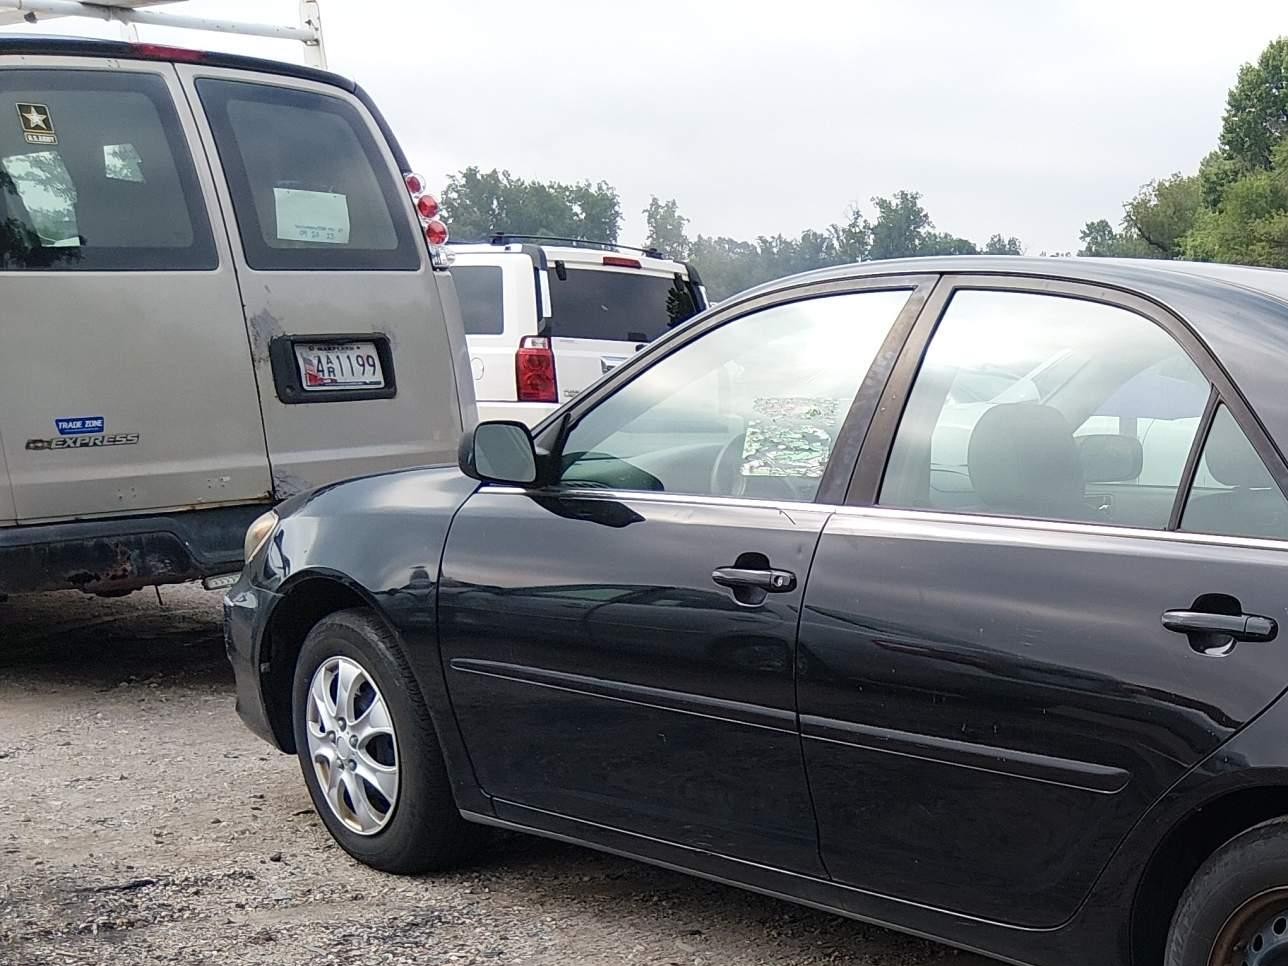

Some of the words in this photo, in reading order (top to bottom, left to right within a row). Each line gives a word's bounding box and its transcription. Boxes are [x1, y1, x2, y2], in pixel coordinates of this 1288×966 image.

[58, 421, 82, 429] TRADE
[85, 419, 103, 427] ZONE
[51, 433, 139, 449] EXPRESS
